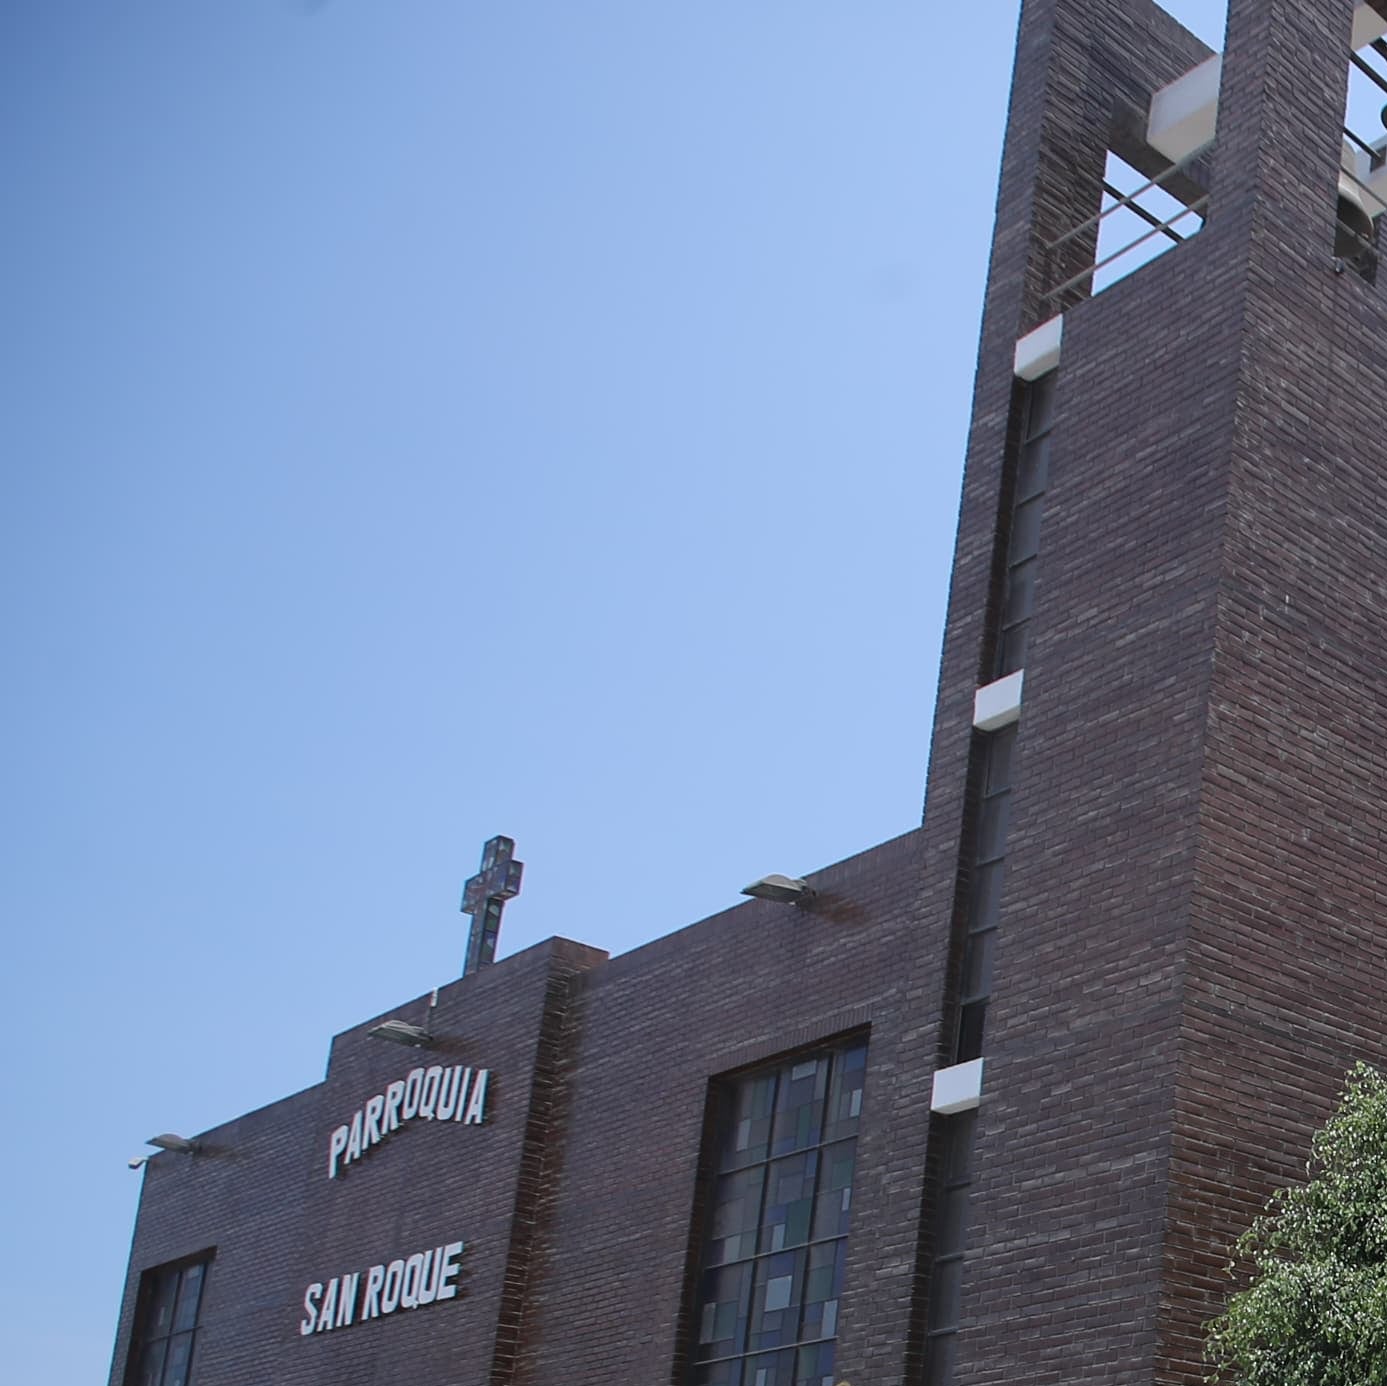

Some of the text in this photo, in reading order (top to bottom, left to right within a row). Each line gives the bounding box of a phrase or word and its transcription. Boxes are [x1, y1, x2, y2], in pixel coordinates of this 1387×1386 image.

[329, 1065, 489, 1179] PARROQUIA
[301, 1241, 464, 1336] SAN ROQUE
